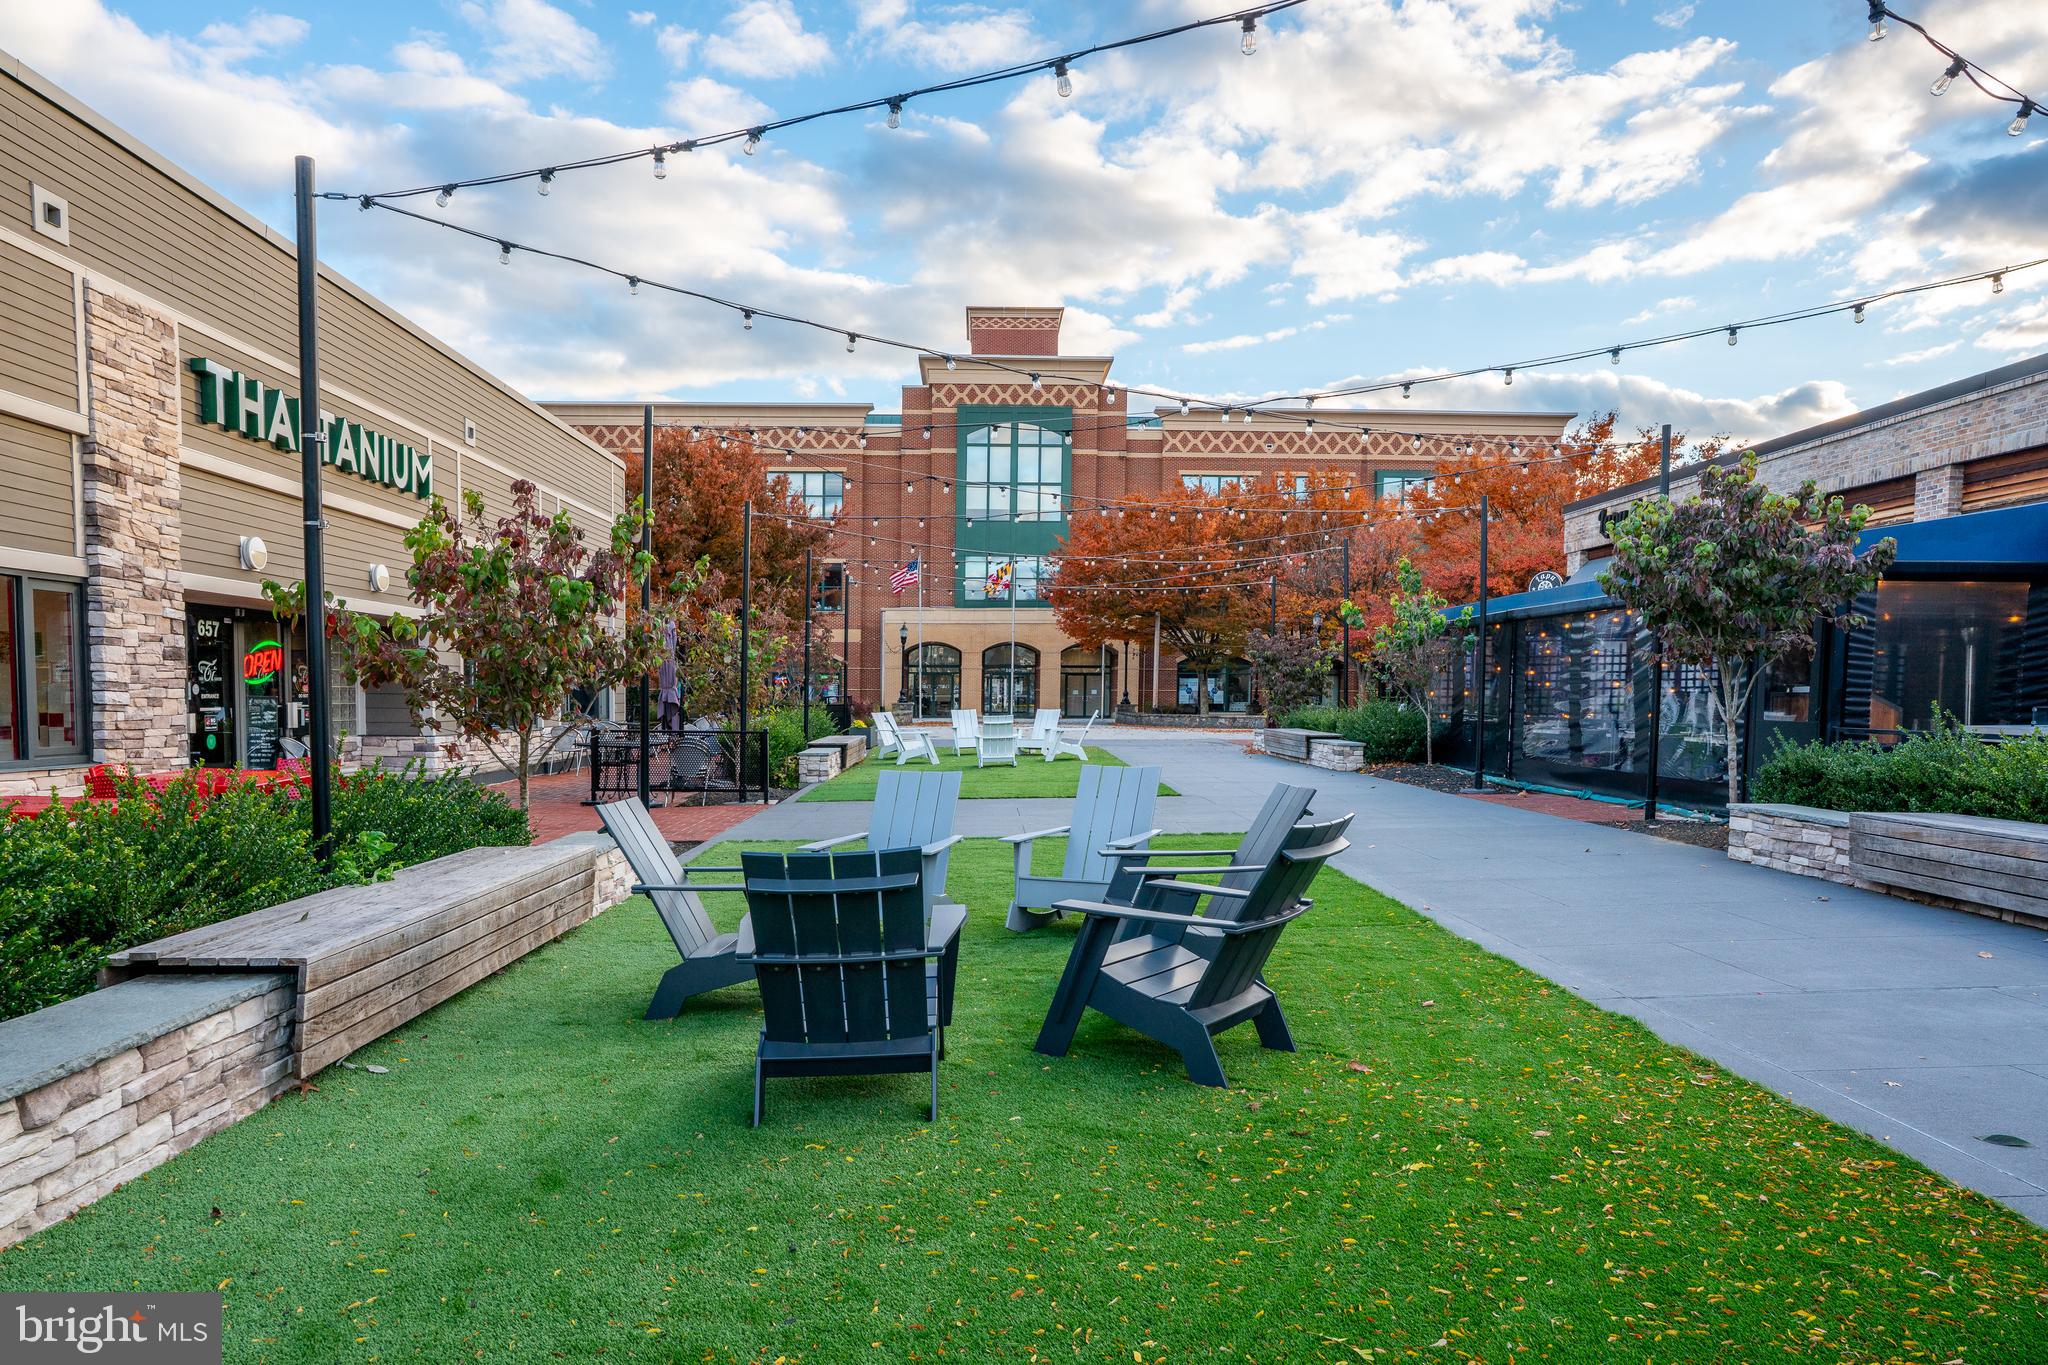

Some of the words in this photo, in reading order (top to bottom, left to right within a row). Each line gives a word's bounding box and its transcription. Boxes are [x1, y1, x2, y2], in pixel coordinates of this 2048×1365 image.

[190, 357, 433, 500] THATANIUM
[197, 619, 220, 637] 657
[243, 648, 283, 678] OPEN
